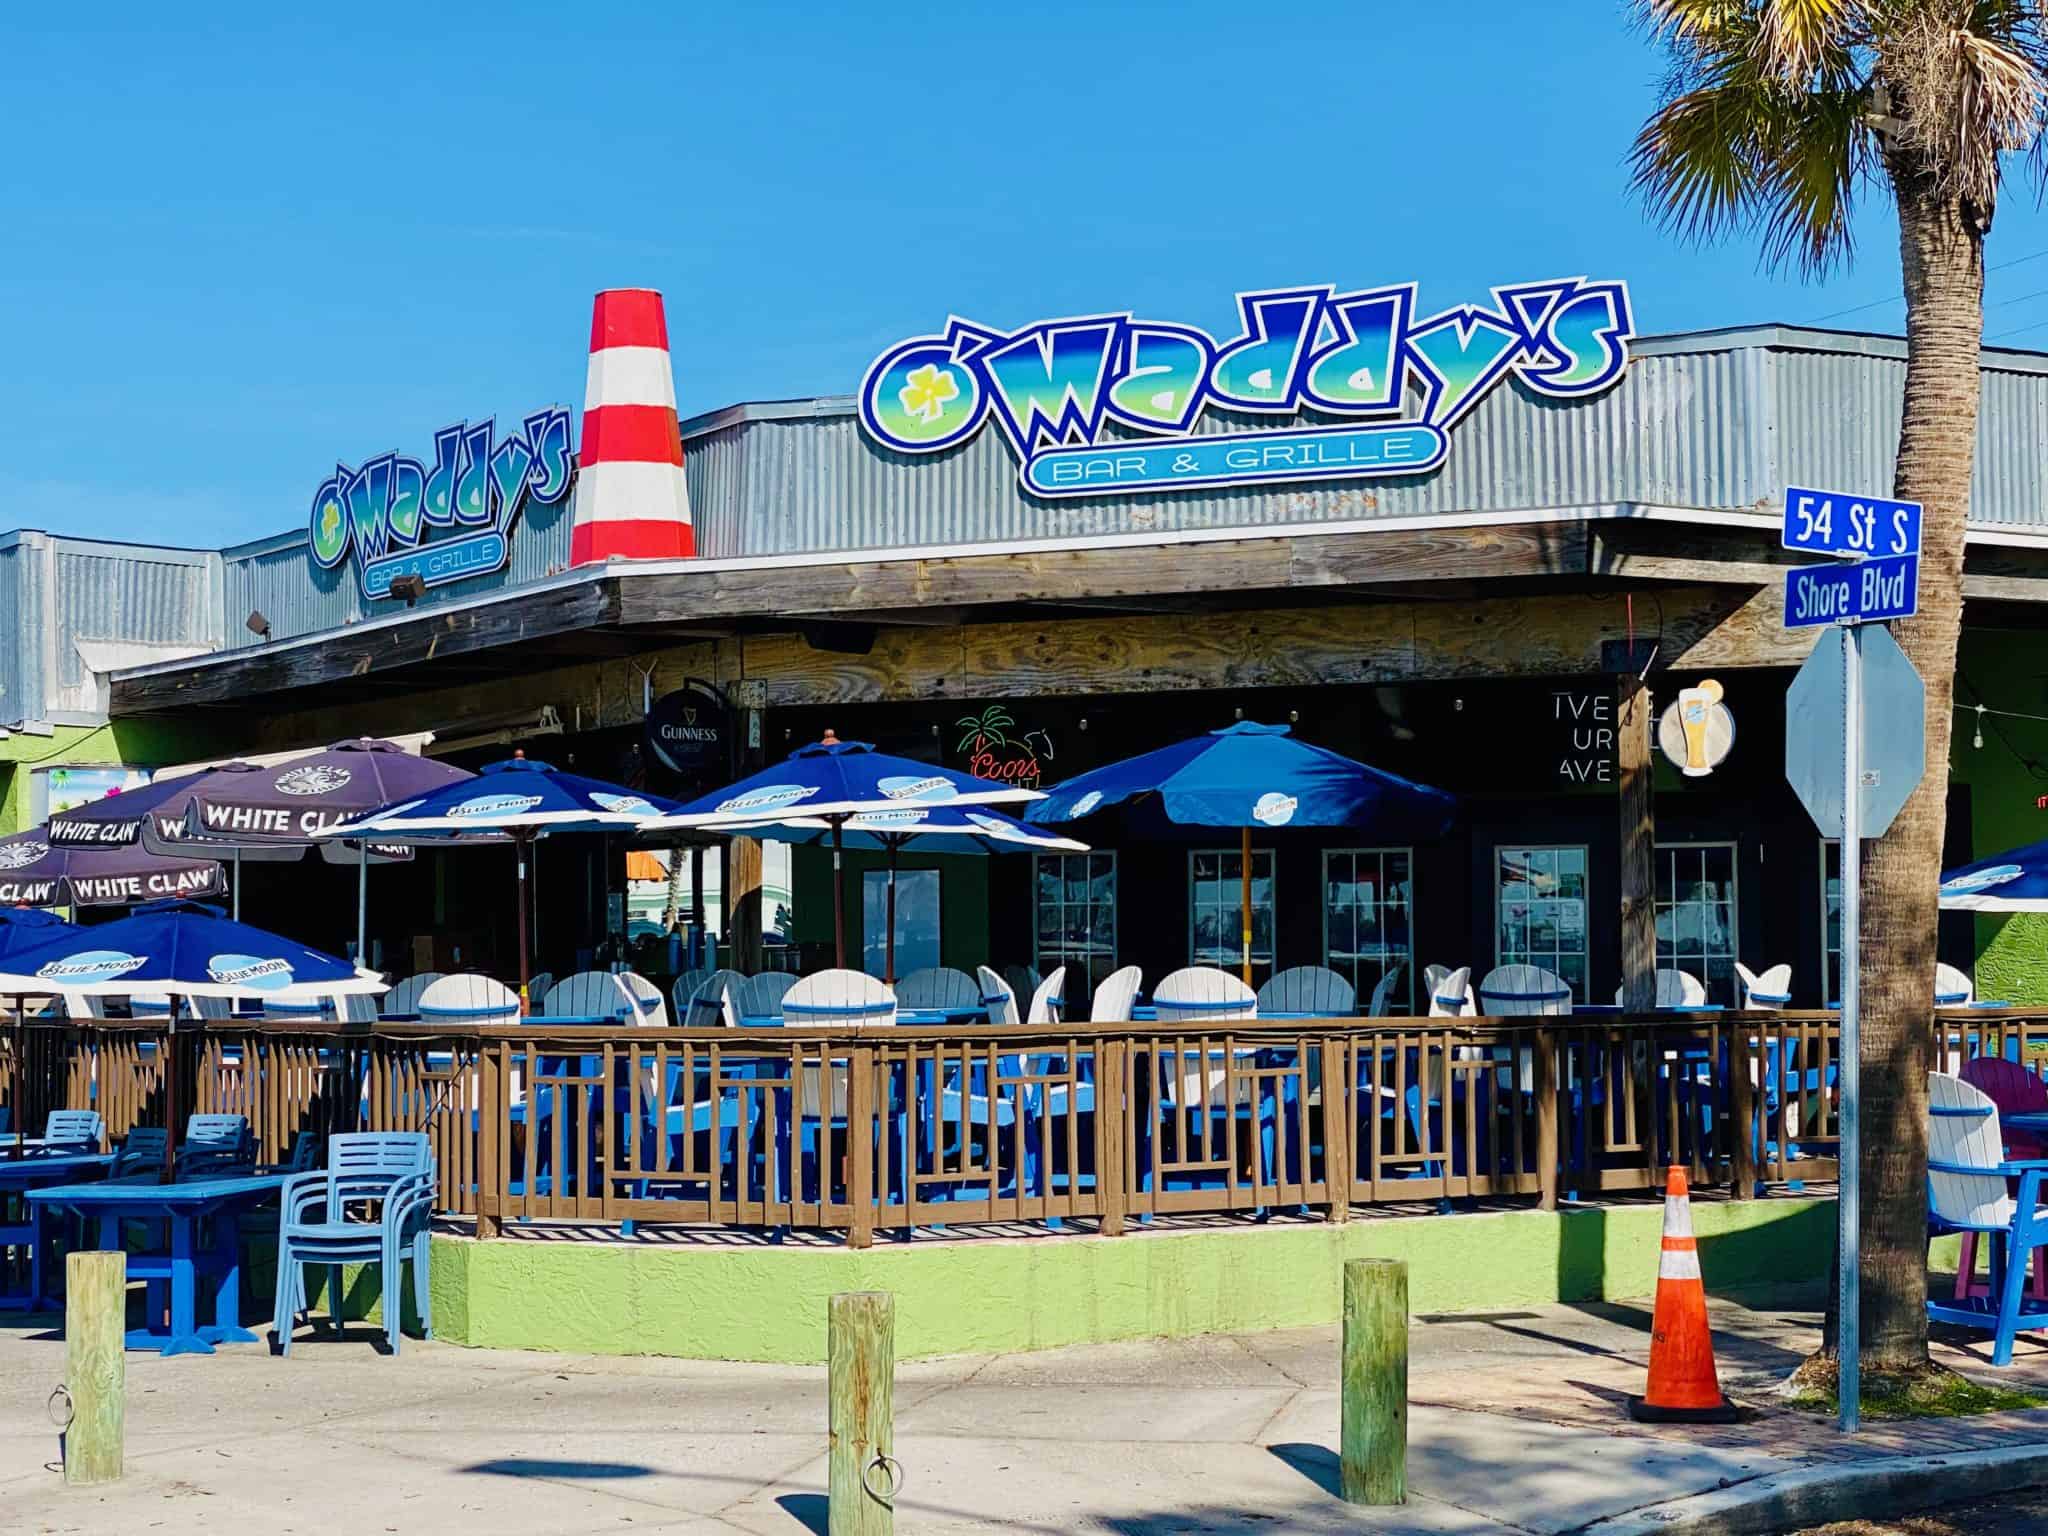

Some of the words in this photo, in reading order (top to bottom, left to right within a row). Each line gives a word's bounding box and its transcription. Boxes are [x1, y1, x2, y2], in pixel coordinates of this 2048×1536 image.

[1052, 457, 1146, 482] BAR
[1172, 454, 1199, 474] &
[1226, 438, 1414, 468] GRILLE
[1796, 497, 1832, 544] 54
[1847, 503, 1876, 550] St
[1890, 509, 1908, 554] S
[429, 543, 496, 573] GRILLE
[1795, 575, 1849, 619] Shore
[1861, 563, 1906, 612] Blvd
[661, 724, 718, 742] GUINNESS
[970, 753, 1039, 779] Coors
[50, 820, 97, 841] WHITE
[207, 804, 291, 831] WHITE
[300, 811, 368, 834] CL
[0, 882, 50, 901] CLAW
[75, 878, 141, 898] WHITE
[148, 869, 210, 892] CLAW
[94, 960, 143, 970] MOON
[249, 961, 288, 975] MOON
